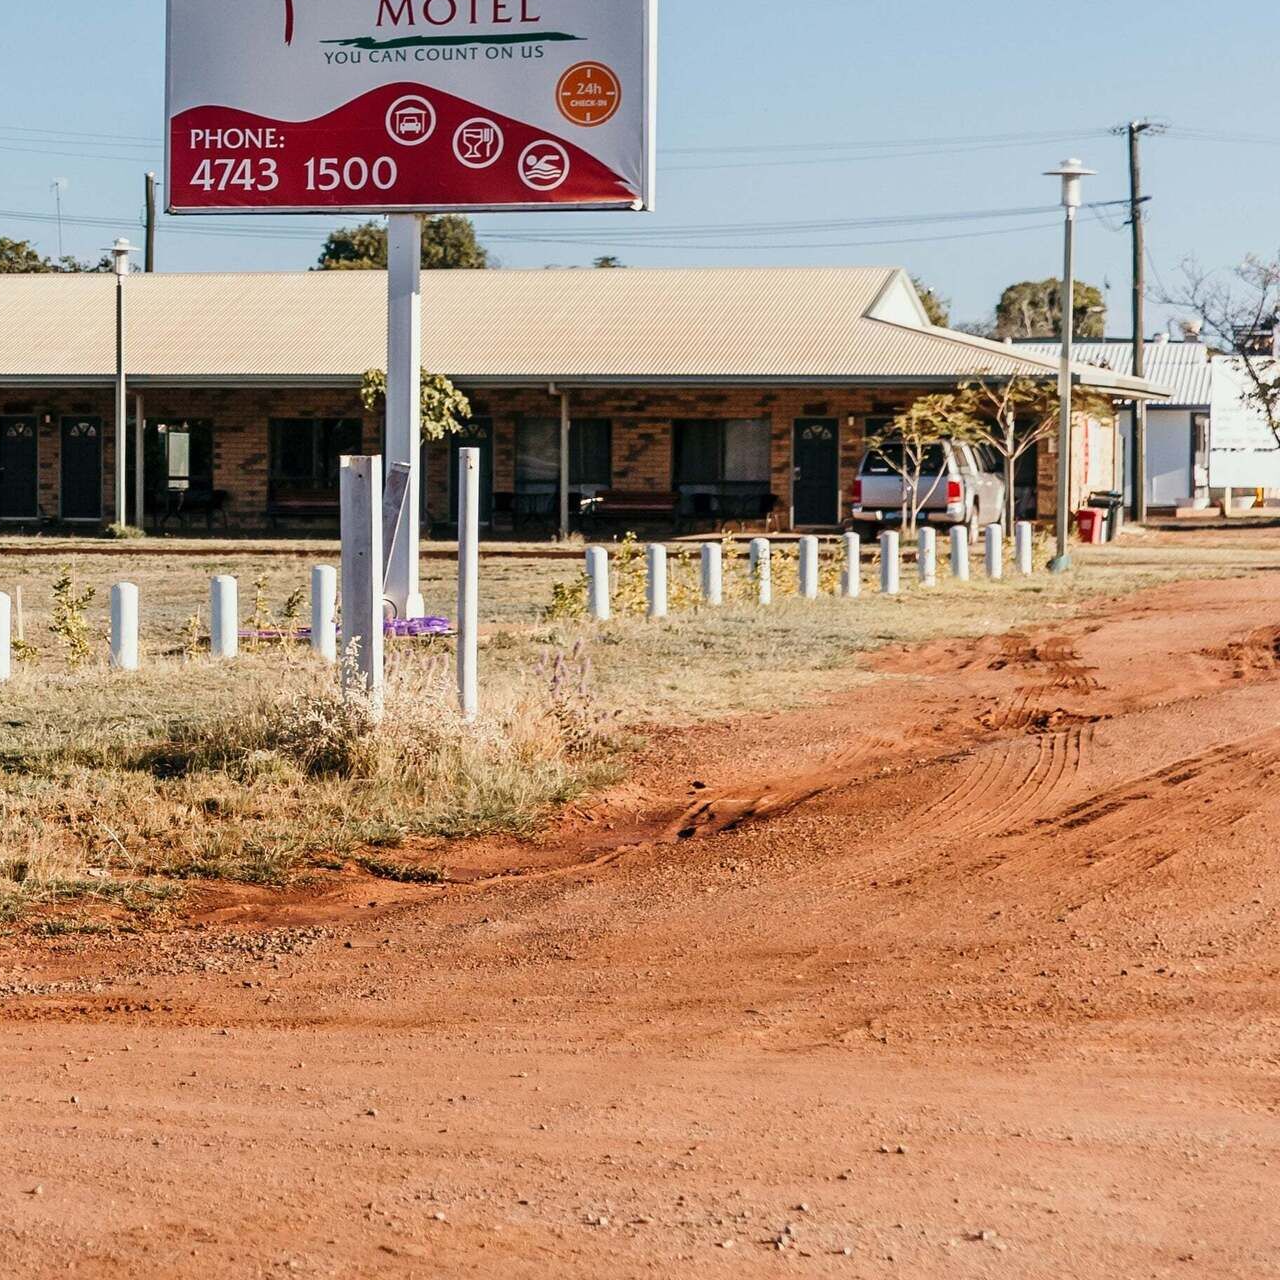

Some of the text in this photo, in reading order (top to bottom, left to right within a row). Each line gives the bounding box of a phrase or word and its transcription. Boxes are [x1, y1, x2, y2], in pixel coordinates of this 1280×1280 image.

[324, 45, 544, 65] YOU CAN COUNT ON US
[576, 83, 602, 95] 24h
[190, 128, 285, 149] PHONE:
[190, 156, 398, 191] 4743 1500
